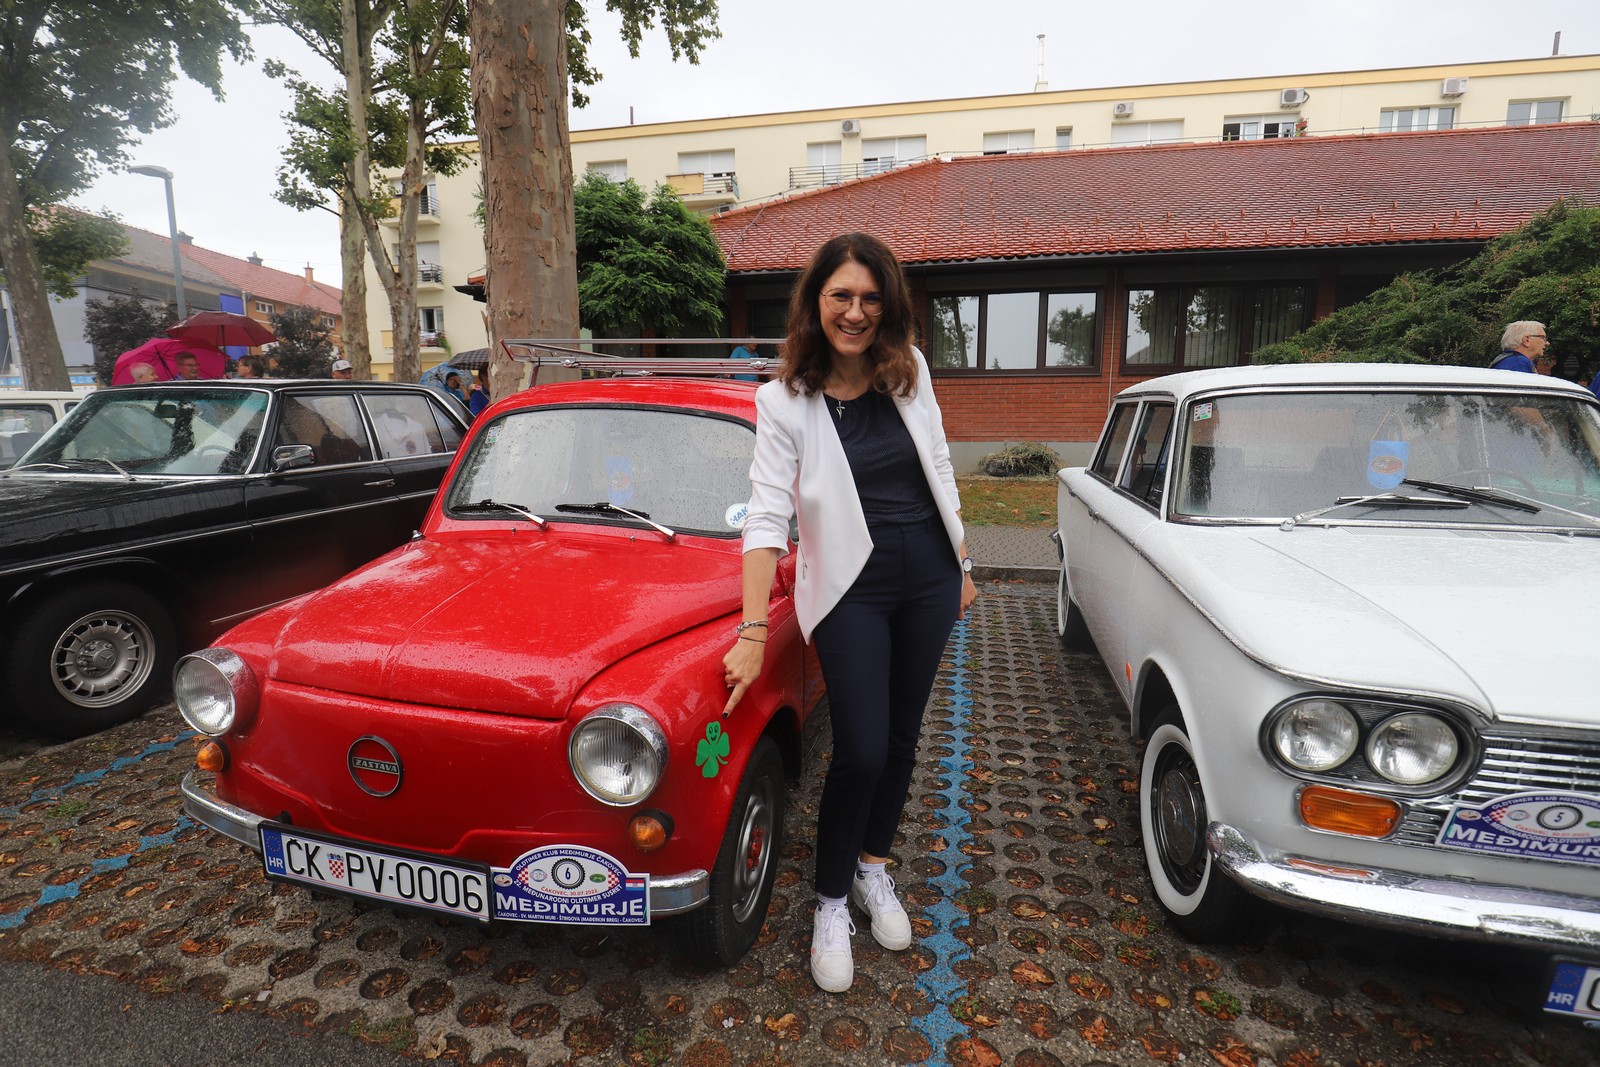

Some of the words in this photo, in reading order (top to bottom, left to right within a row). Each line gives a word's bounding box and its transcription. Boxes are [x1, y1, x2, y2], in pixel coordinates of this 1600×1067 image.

[355, 760, 397, 773] ZASTAVA
[1554, 812, 1565, 823] 5
[268, 857, 284, 869] HR
[286, 837, 325, 880] ČK
[516, 854, 542, 871] OLDTIMER
[542, 849, 558, 857] KLUB
[596, 856, 622, 876] ČAKOVEC
[565, 867, 571, 880] 6
[570, 894, 602, 904] OLDTIMER
[602, 884, 623, 899] SUSRET
[496, 892, 643, 916] MEĐIMURJE
[1547, 991, 1575, 1006] HR
